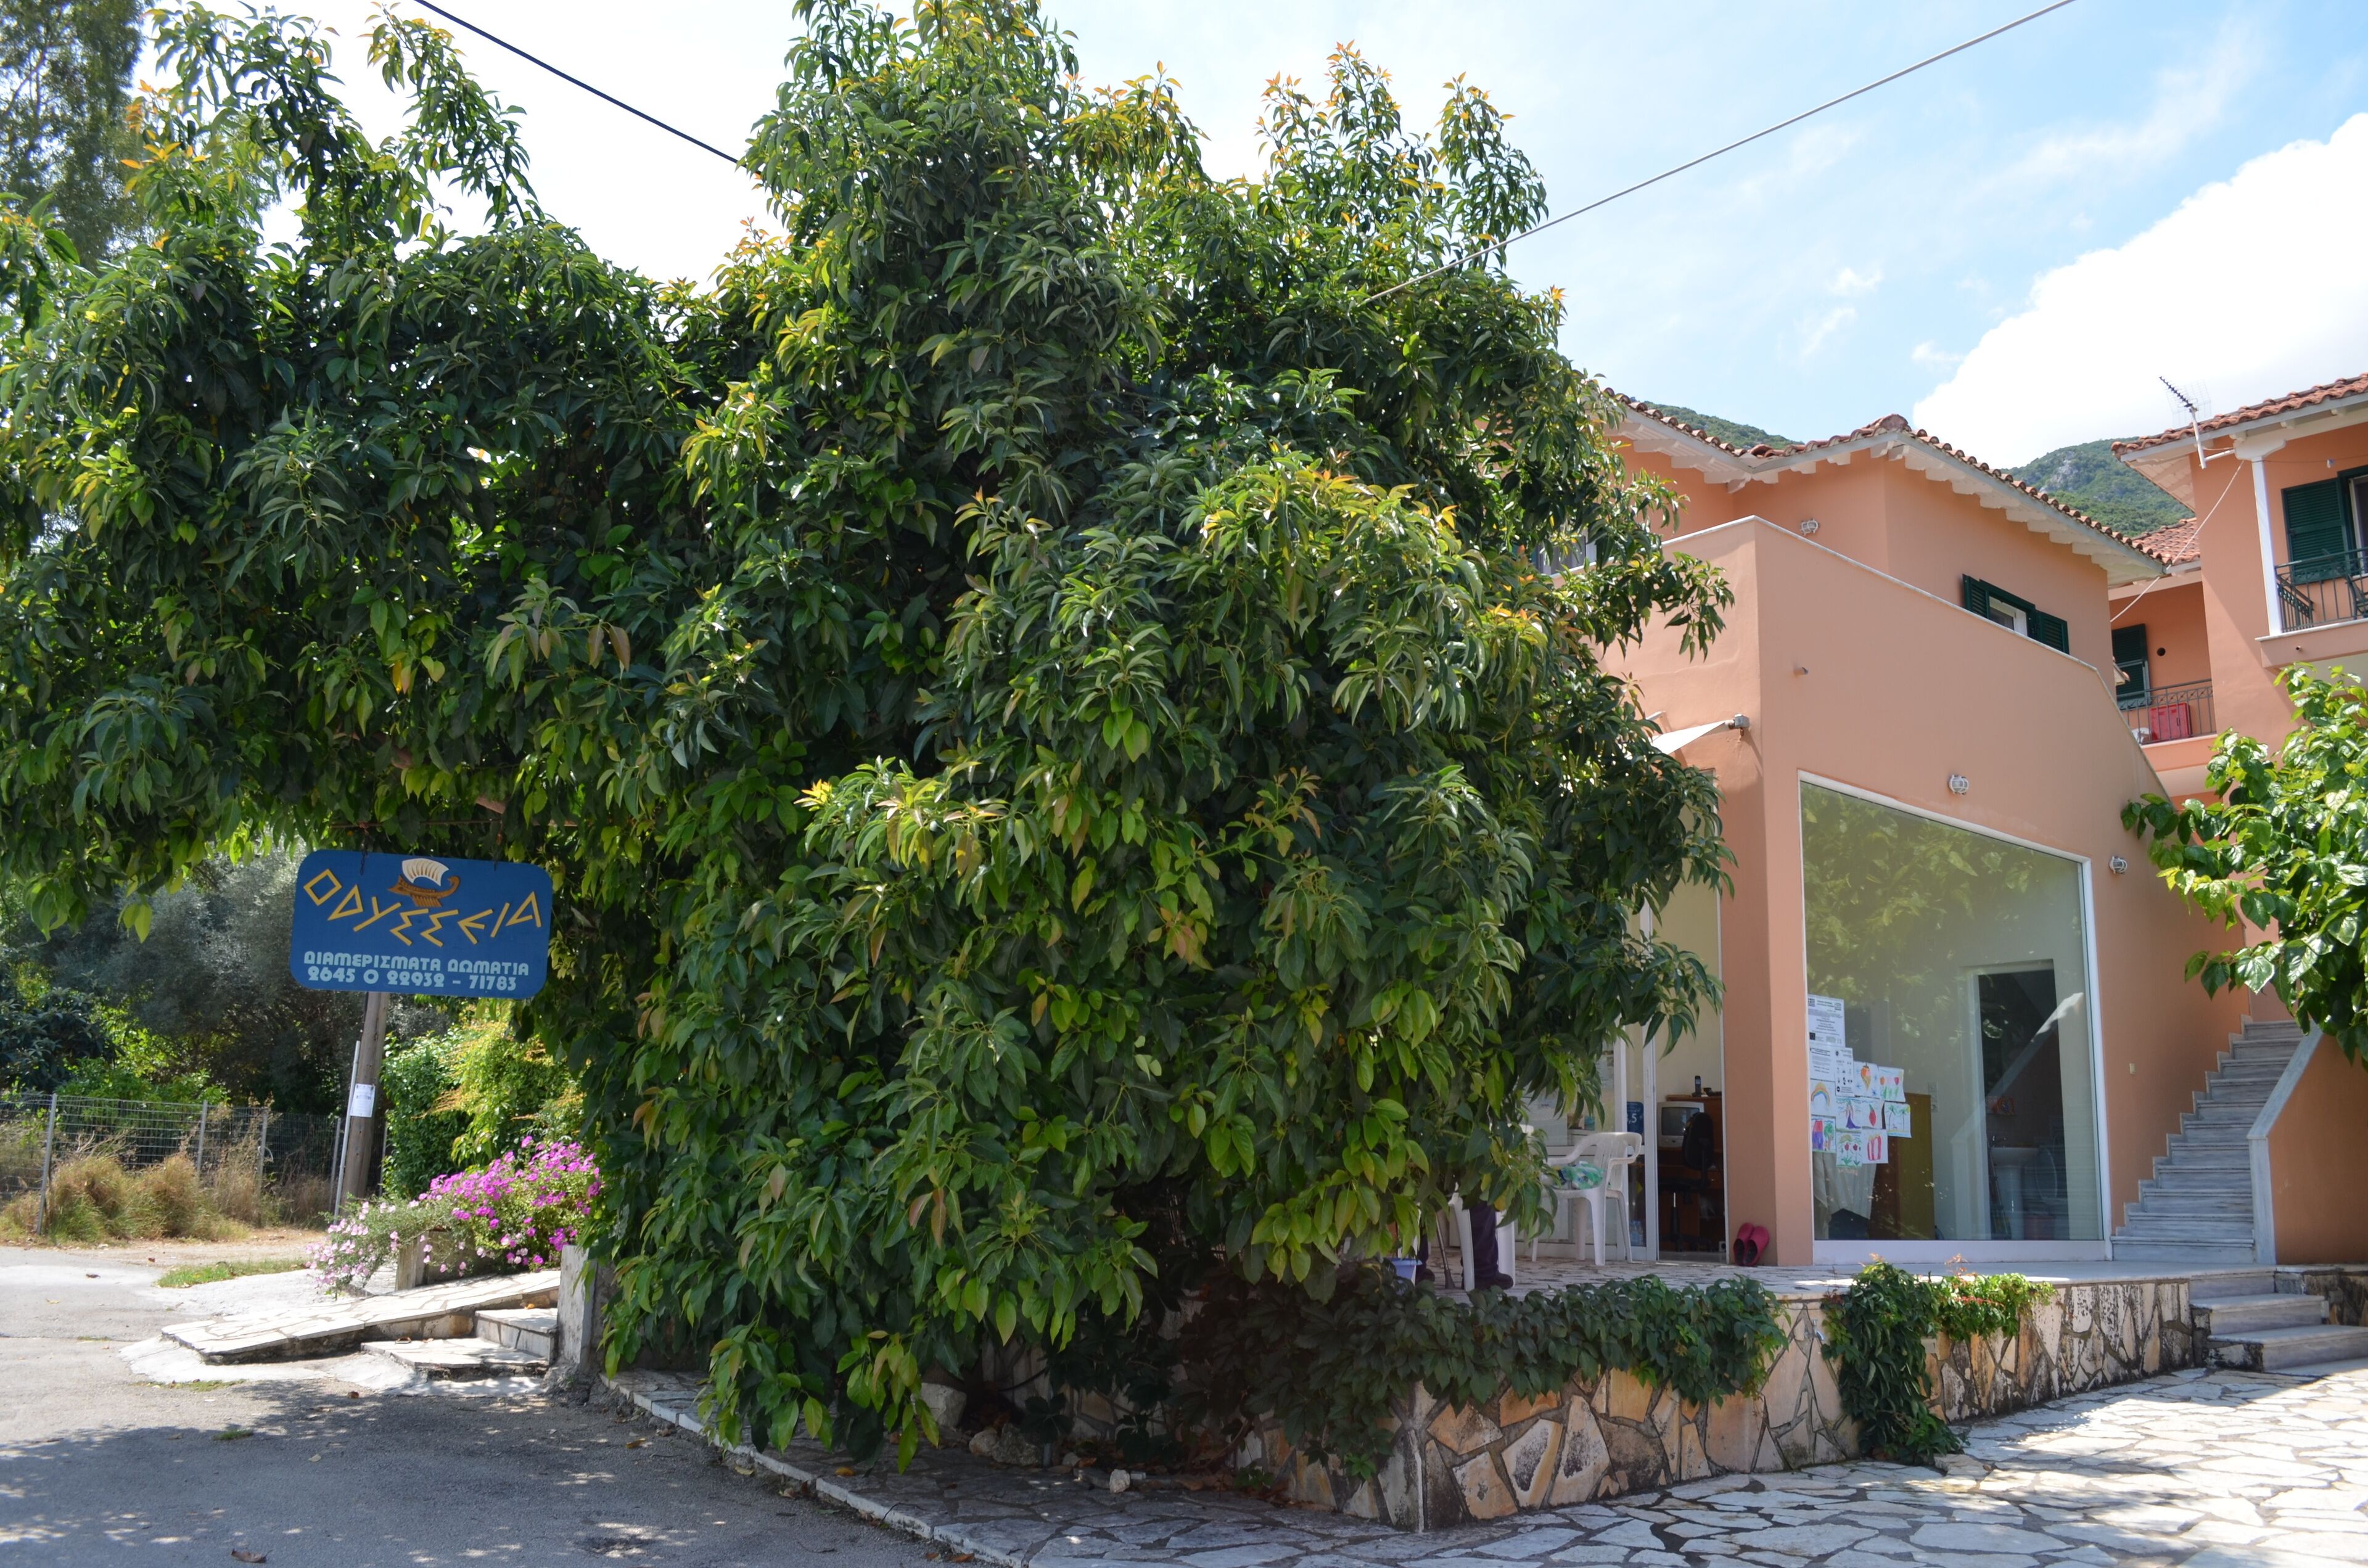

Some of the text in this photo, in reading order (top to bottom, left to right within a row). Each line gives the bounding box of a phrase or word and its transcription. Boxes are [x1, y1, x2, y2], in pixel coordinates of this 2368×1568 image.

[303, 951, 529, 976] ΔΙΑΜΕΡΙΣΜΑΤΑ ΔΩΜΑΤΙΑ
[307, 966, 355, 983] 2645
[387, 970, 445, 988] 22932
[469, 975, 517, 991] 71783
